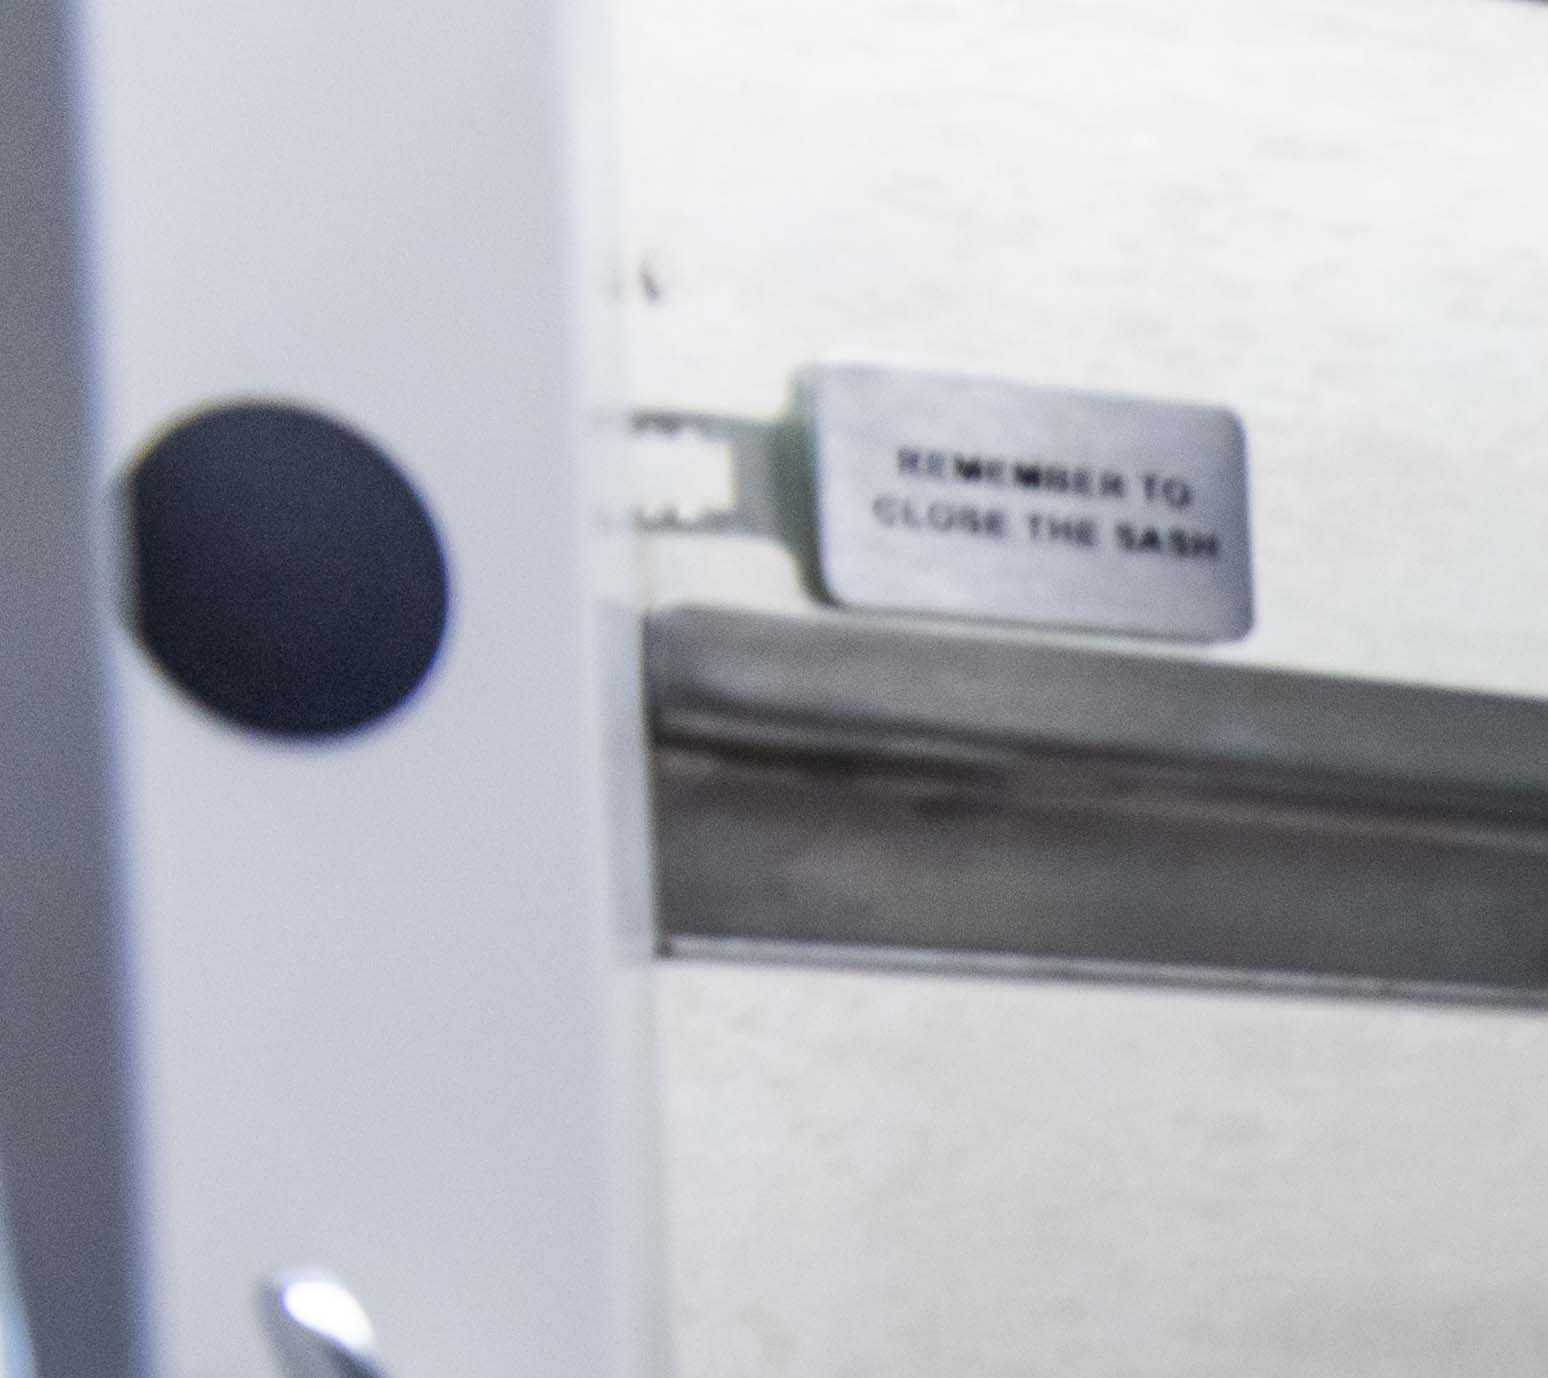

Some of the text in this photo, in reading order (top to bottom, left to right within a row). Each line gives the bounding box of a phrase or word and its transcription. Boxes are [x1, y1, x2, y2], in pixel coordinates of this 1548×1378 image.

[897, 445, 1194, 509] REMEMBER TO
[873, 494, 1219, 559] CLOSE THE SASH
